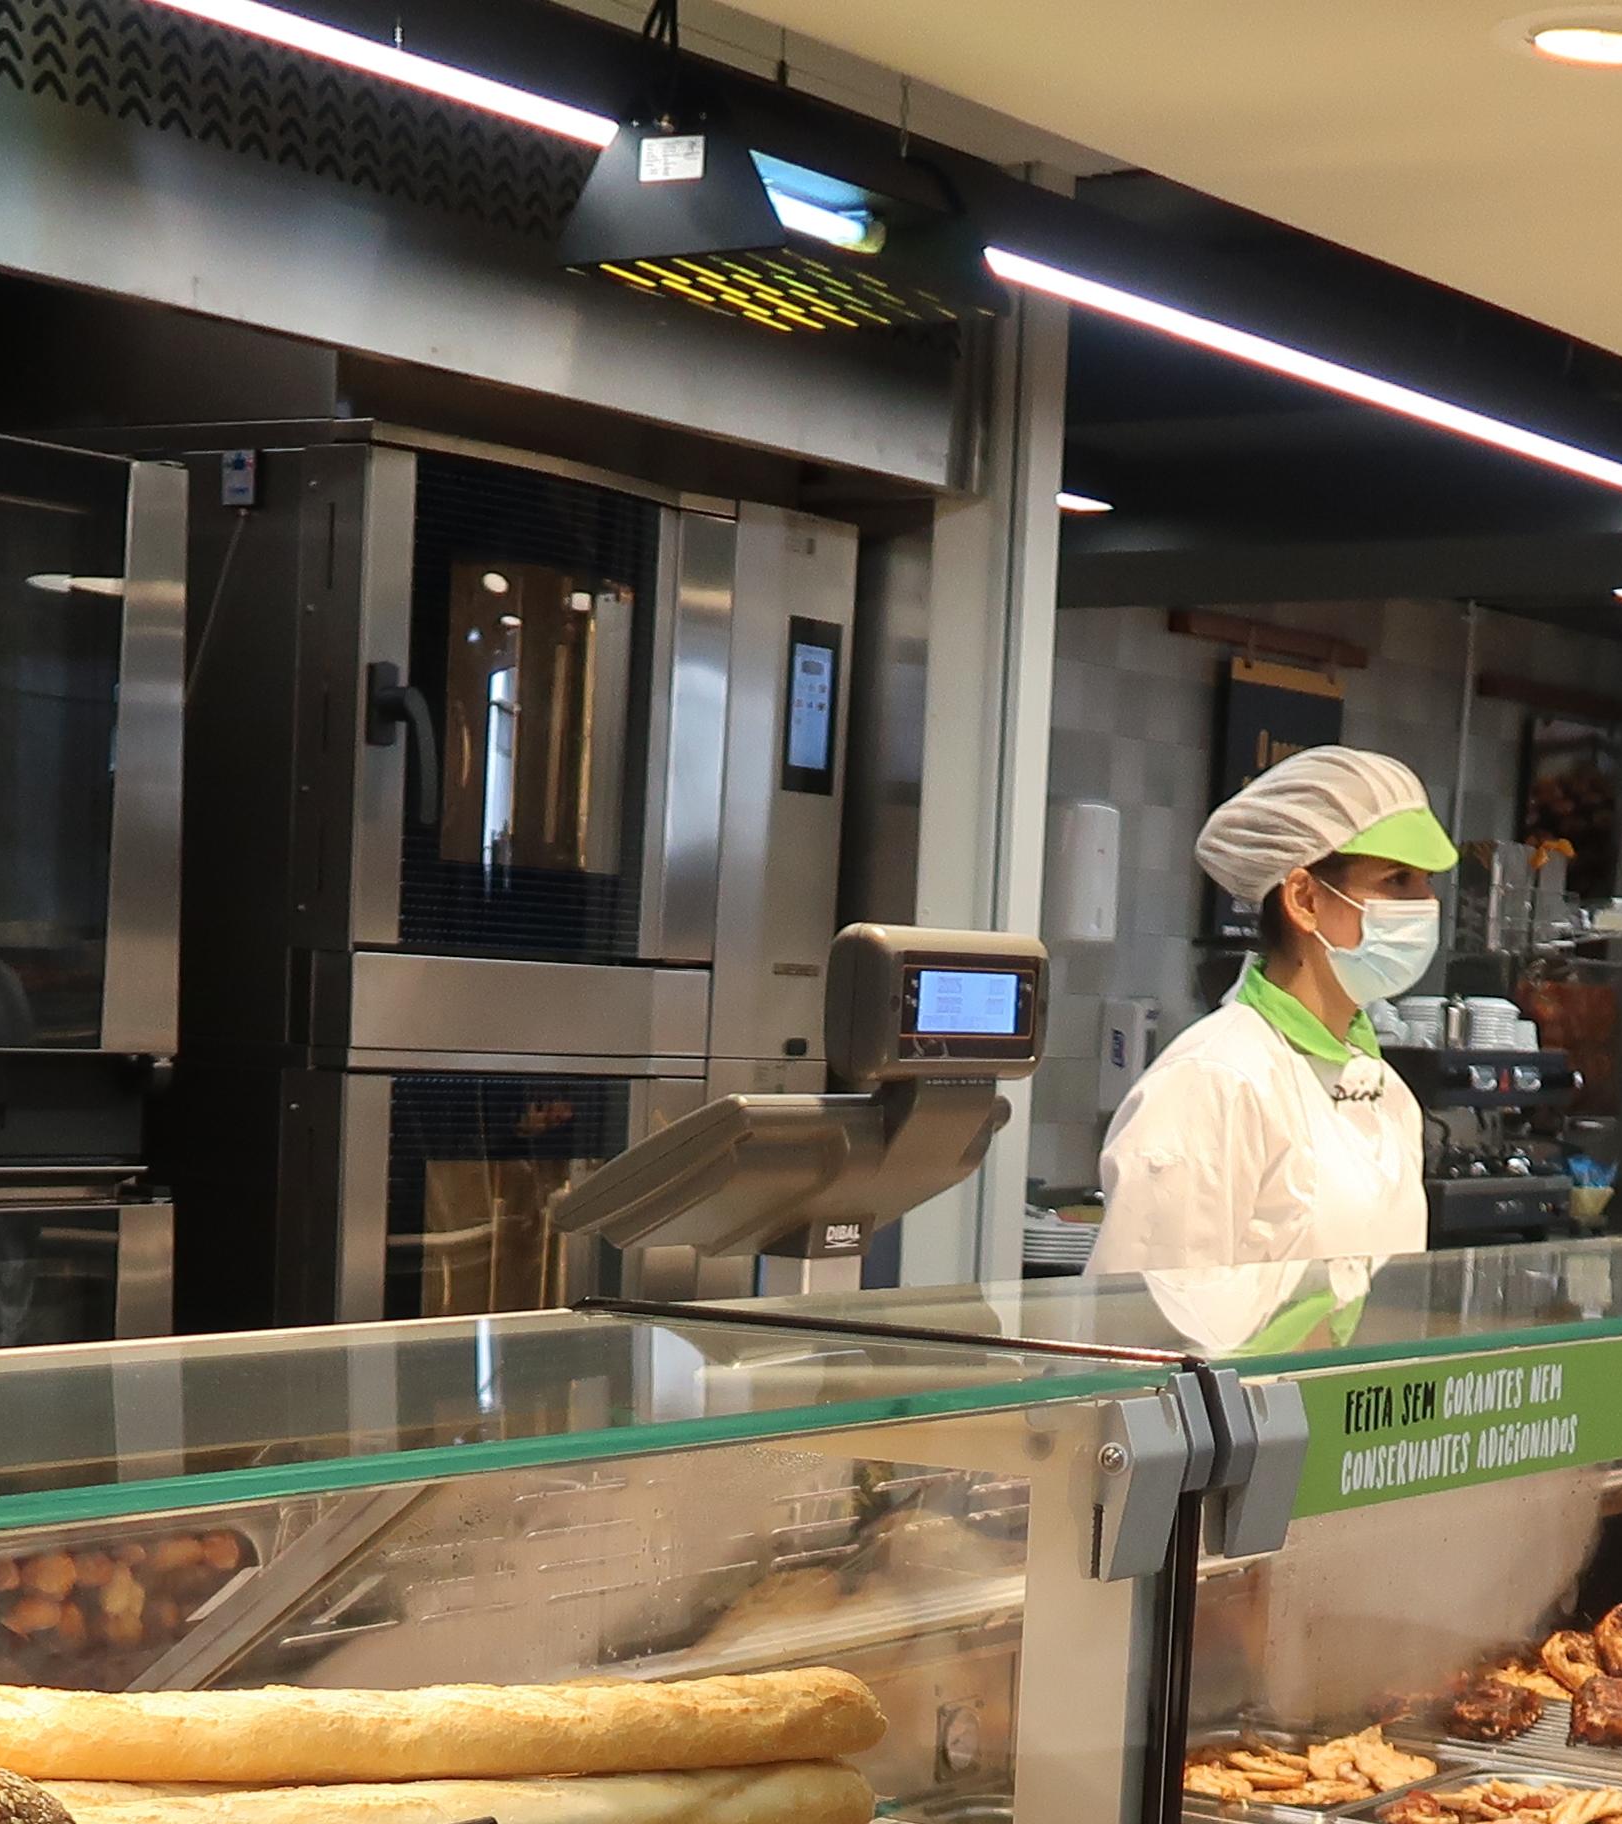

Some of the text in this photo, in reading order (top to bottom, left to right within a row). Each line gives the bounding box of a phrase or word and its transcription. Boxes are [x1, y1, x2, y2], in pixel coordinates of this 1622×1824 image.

[1401, 1380, 1436, 1426] SEM
[1442, 1367, 1525, 1420] CORANTES
[1529, 1363, 1563, 1404] NEM
[1340, 1431, 1471, 1496] CONSERVANTES
